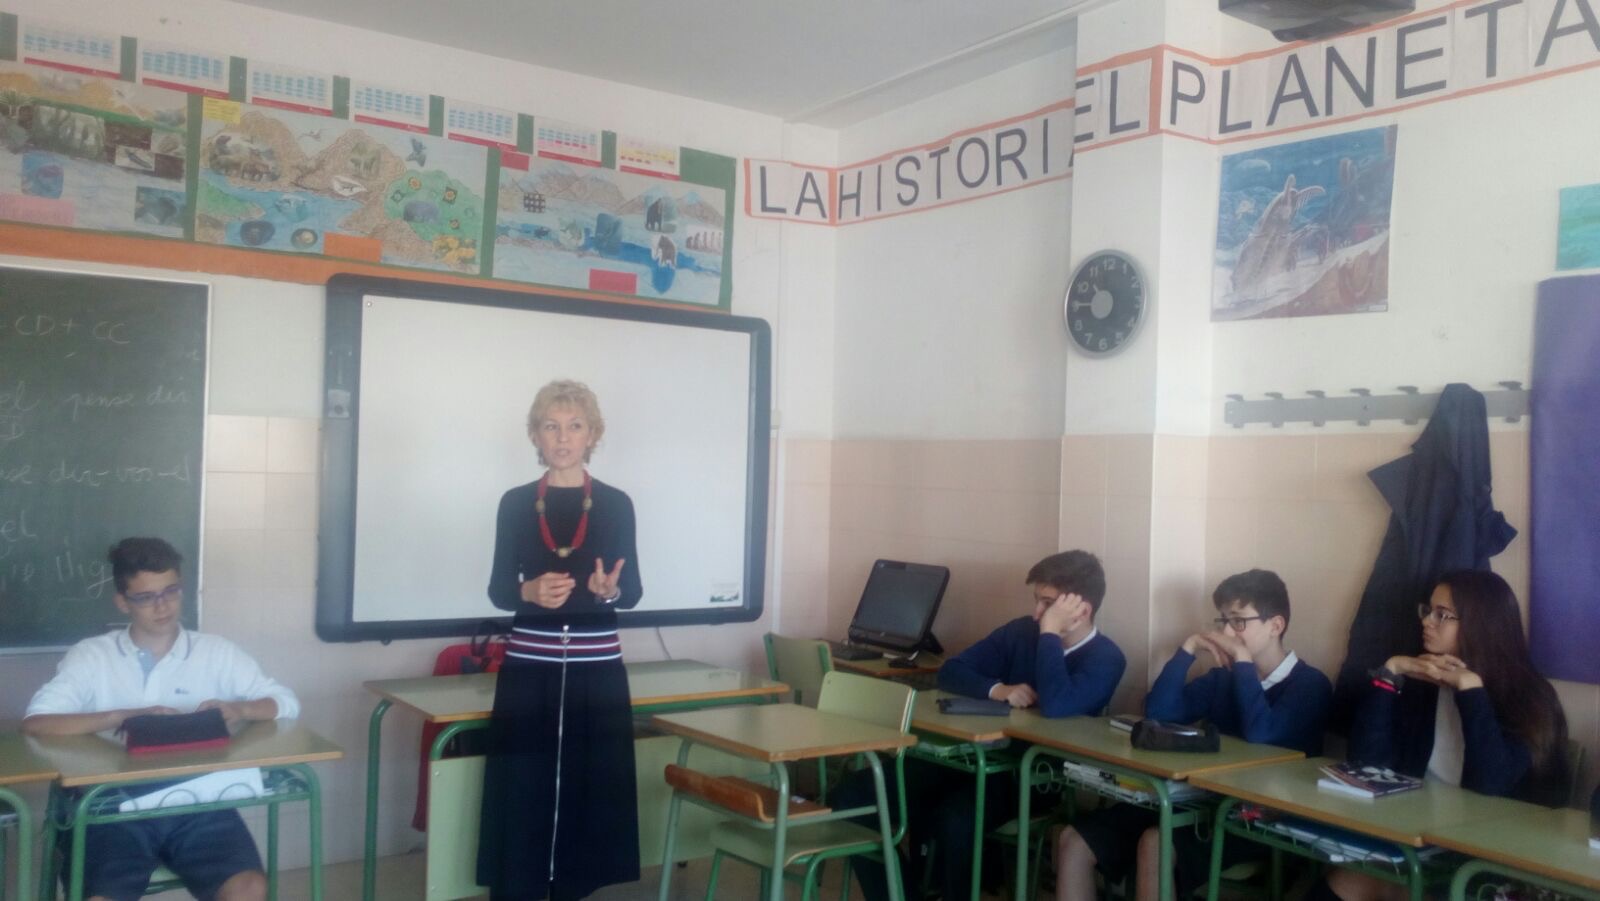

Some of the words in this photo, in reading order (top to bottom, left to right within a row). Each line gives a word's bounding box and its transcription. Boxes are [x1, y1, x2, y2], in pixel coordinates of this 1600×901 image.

[759, 165, 828, 219] LA
[837, 117, 1074, 221] HISTORI
[1169, 0, 1600, 136] PLANETA
[1102, 257, 1117, 271] 12
[1088, 265, 1099, 278] 11
[1084, 332, 1093, 345] 7
[1098, 338, 1108, 351] 6
